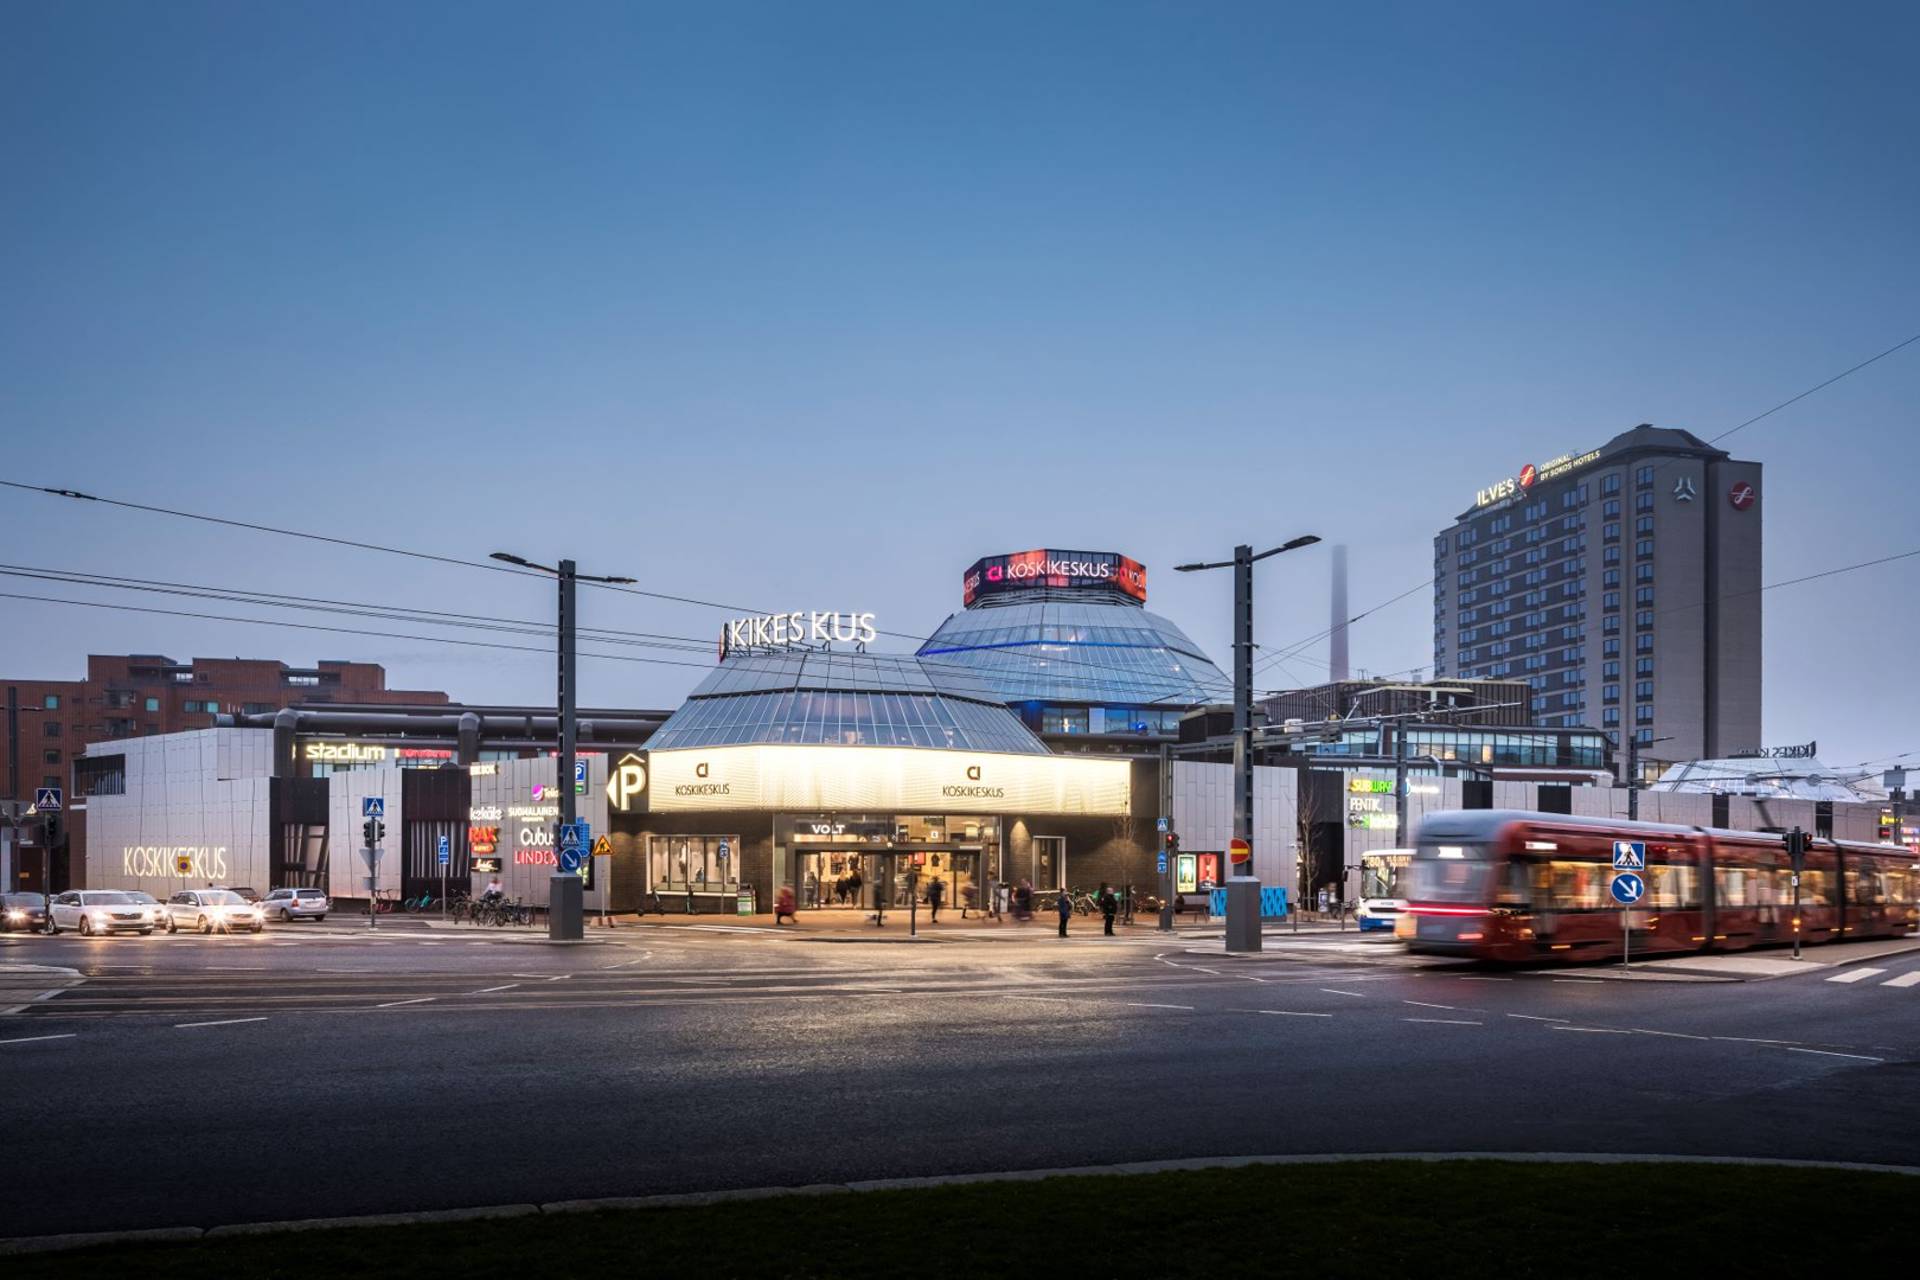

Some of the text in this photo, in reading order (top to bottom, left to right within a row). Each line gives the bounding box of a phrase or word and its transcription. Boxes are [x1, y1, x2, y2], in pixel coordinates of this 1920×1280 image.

[1540, 473, 1549, 481] BY
[1573, 450, 1601, 468] HOTELS
[1476, 478, 1516, 506] ILVES
[1007, 561, 1109, 579] KOSKIKESKUS
[811, 611, 877, 643] KUS
[306, 743, 386, 761] stadium
[620, 765, 647, 811] P
[675, 783, 730, 796] KOSKIKESKUS
[942, 785, 1004, 798] KOSKIKESKUS
[1351, 779, 1393, 793] SUBWAY
[812, 824, 845, 834] VOLT
